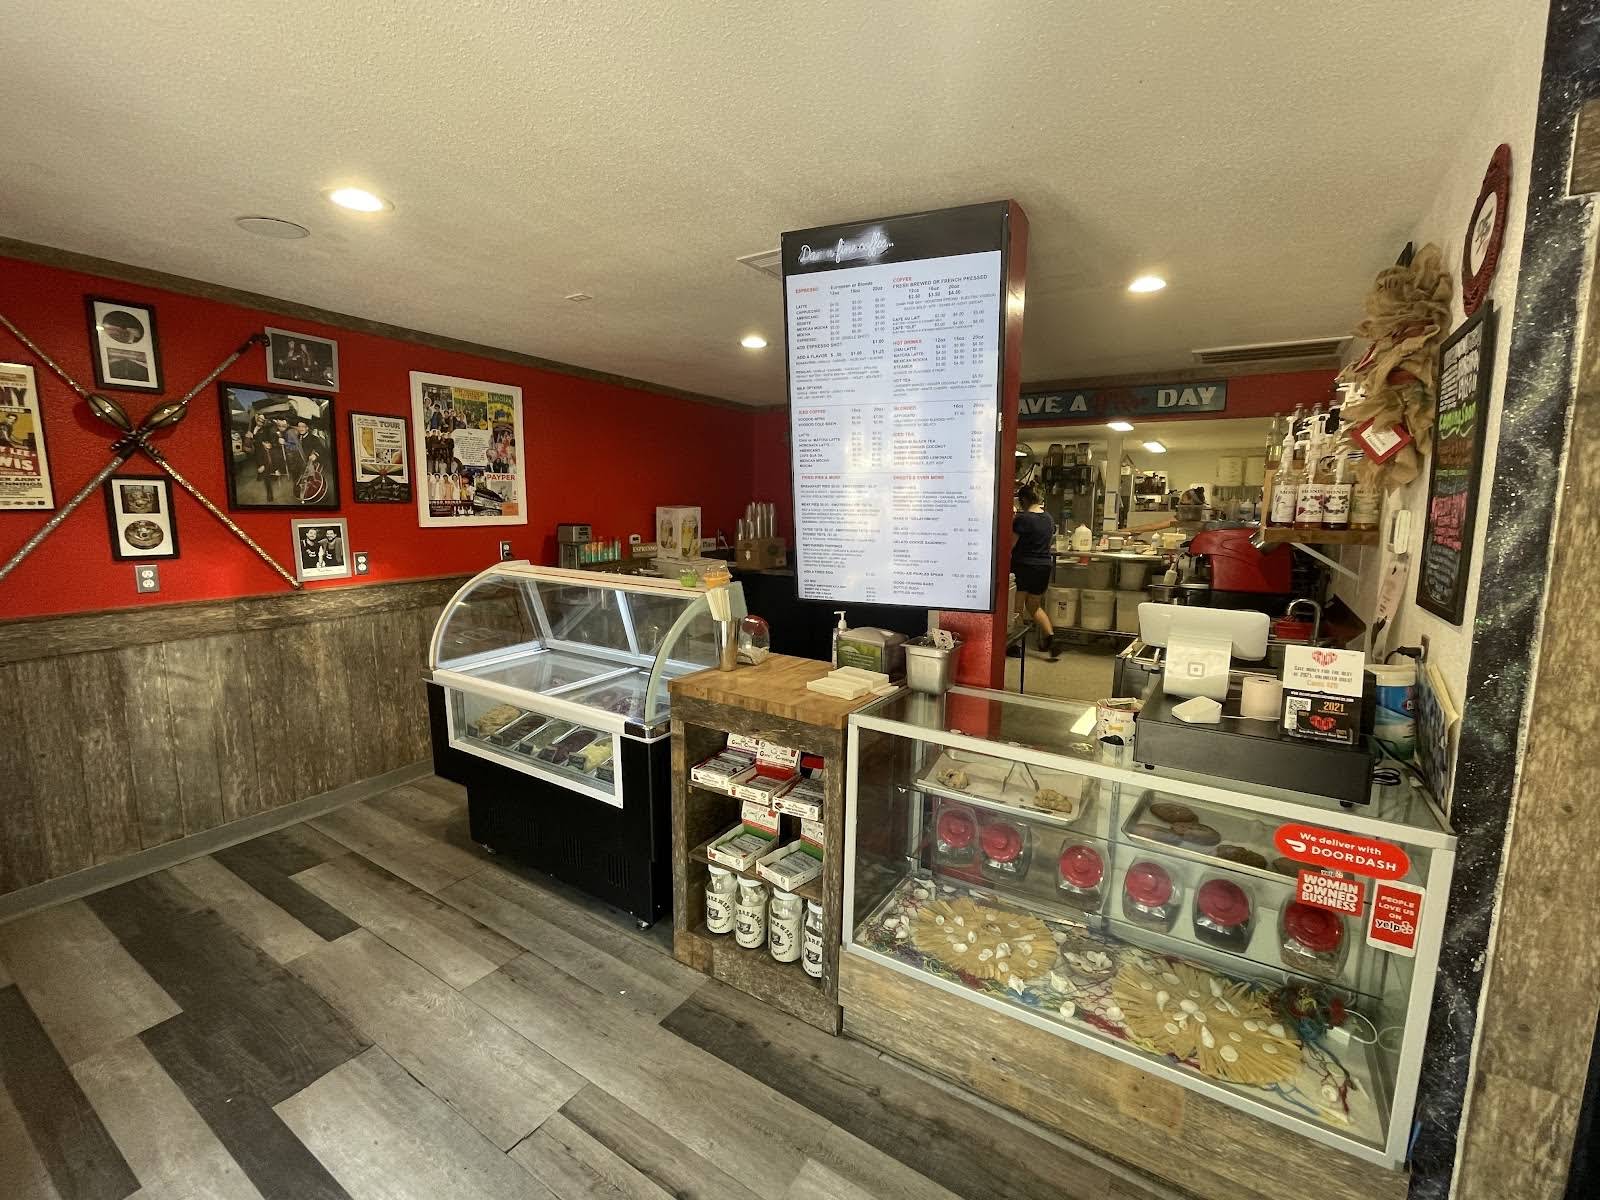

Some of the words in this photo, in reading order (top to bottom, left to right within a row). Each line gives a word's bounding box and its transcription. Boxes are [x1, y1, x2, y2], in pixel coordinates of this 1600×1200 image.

[1018, 396, 1064, 415] AVE
[1070, 395, 1087, 412] A
[1157, 386, 1217, 408] DAY
[1323, 701, 1344, 712] 2021
[1300, 831, 1317, 842] We
[1319, 833, 1356, 851] deliver
[1357, 844, 1382, 856] with
[1311, 846, 1397, 872] DOORDASH
[1302, 883, 1358, 903] OWNED
[1303, 873, 1358, 894] WOMAN
[1302, 891, 1357, 912] BUSINESS
[1378, 903, 1401, 914] LOVE
[1403, 908, 1415, 916] US
[1381, 895, 1415, 909] PEOPLE
[1375, 918, 1400, 932] yelp
[1388, 912, 1402, 920] ON
